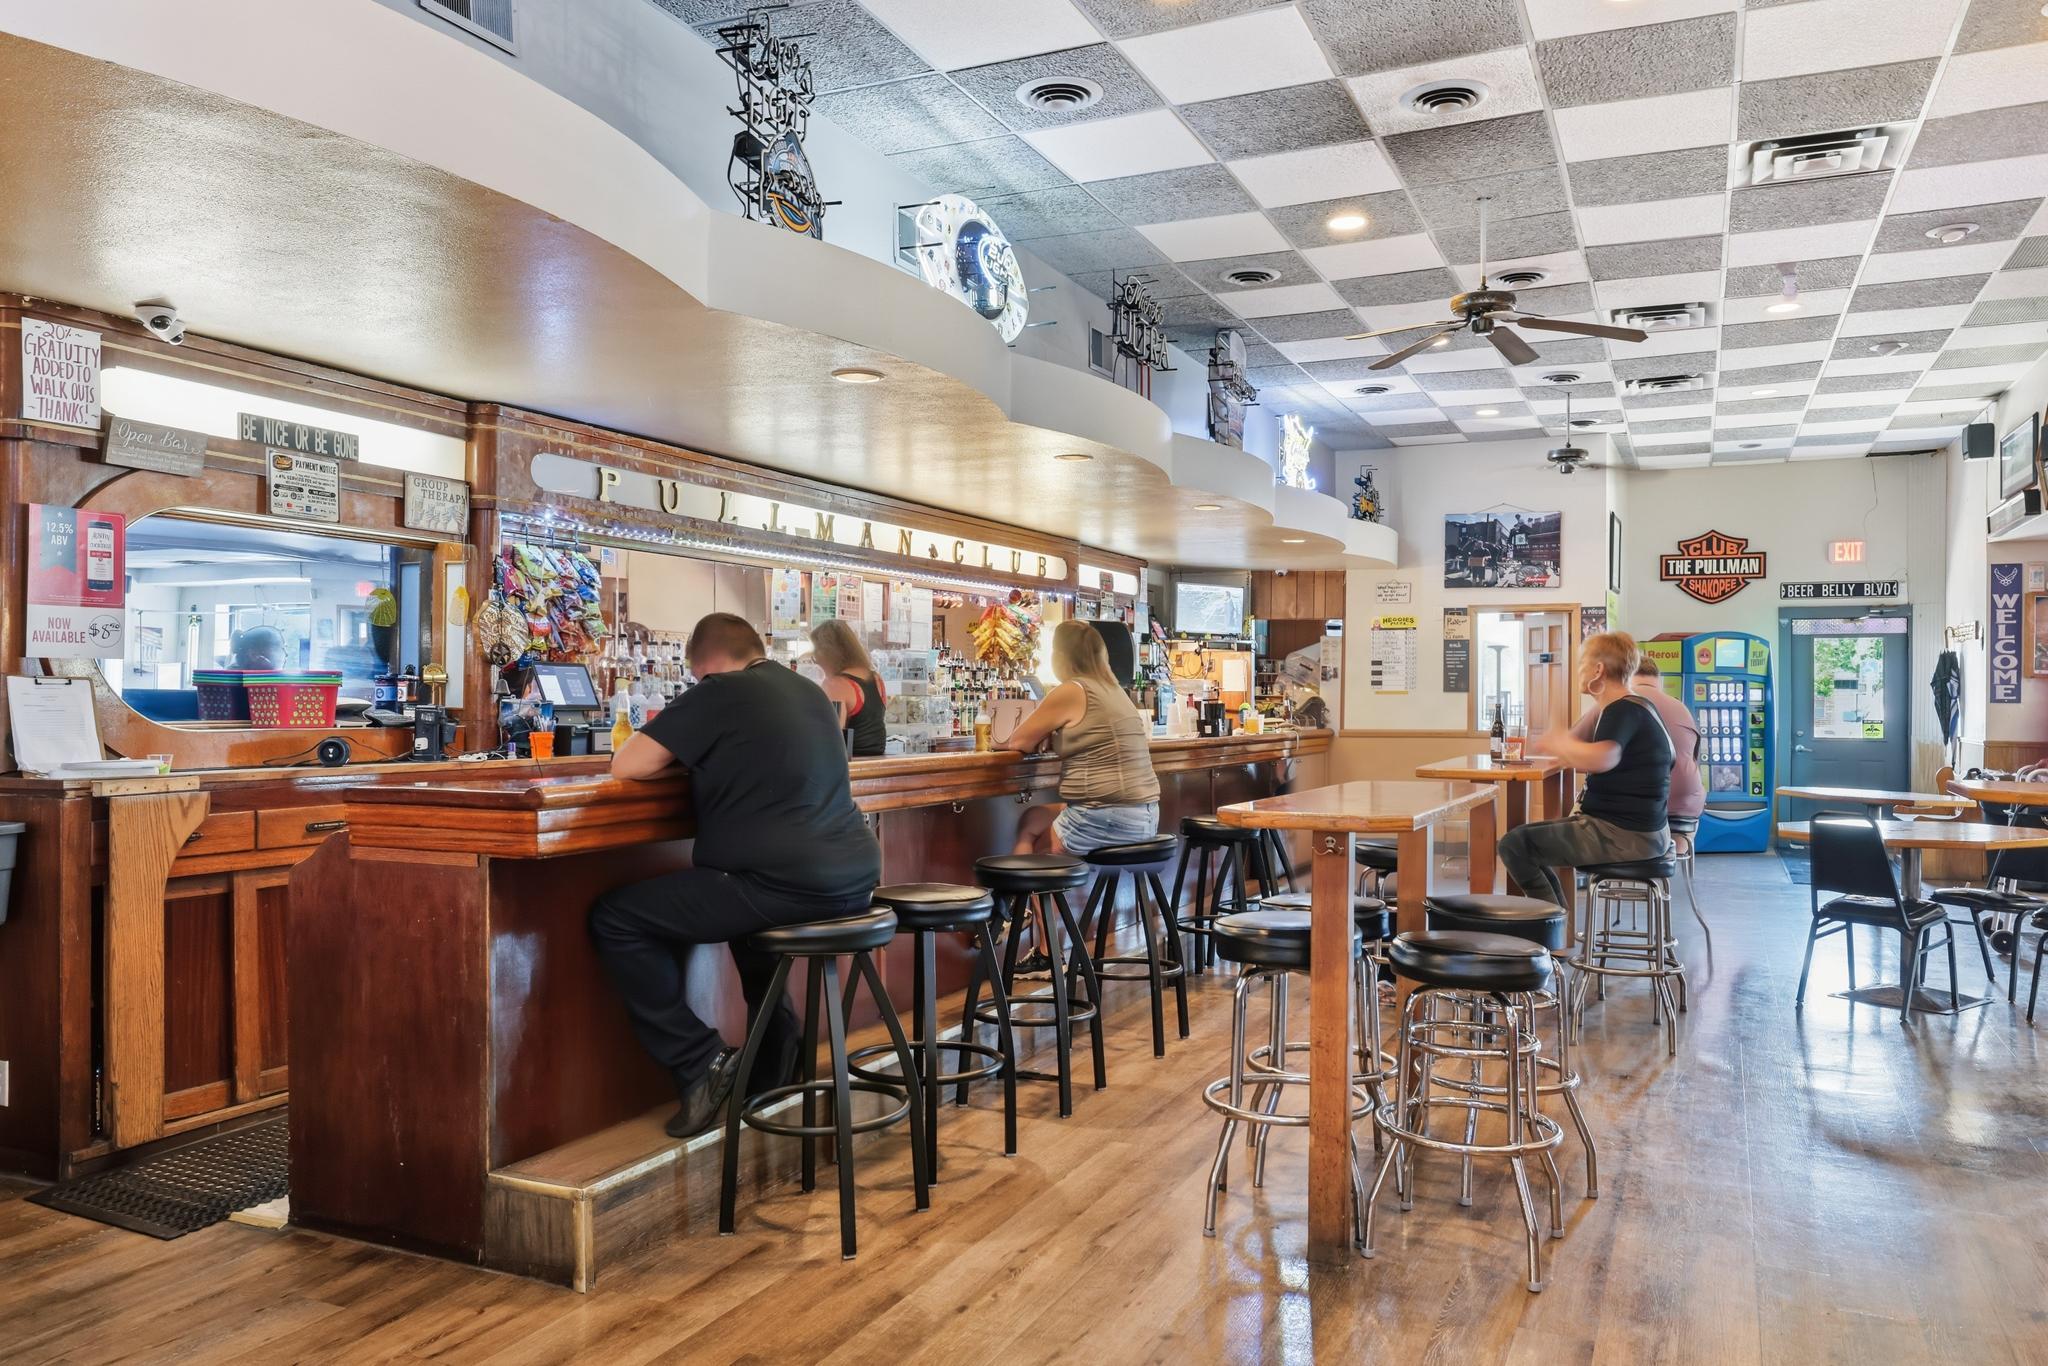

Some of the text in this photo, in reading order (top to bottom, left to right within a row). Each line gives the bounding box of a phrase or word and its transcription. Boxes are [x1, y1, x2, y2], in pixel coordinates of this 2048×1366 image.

[42, 322, 72, 341] 20%
[24, 333, 100, 368] GRATUITY
[33, 357, 92, 383] ADDED TO
[30, 374, 95, 404] WALK OUTS
[35, 396, 89, 425] THANKS!
[118, 421, 201, 455] Open Bar
[242, 414, 359, 460] BE NICE OR BE GONE
[295, 459, 319, 472] PAYMENT
[319, 464, 337, 476] NOTICE
[413, 477, 449, 492] GROUP
[421, 488, 467, 505] THERAPY
[46, 521, 74, 535] 12.5%
[597, 466, 1048, 578] PULLMAN CLUB
[50, 534, 69, 546] ABV
[1688, 536, 1738, 556] CLUB
[1834, 541, 1864, 561] EXIT
[1667, 558, 1760, 575] THE PULLMAN
[1688, 578, 1737, 598] SHAKOPEE
[1787, 582, 1891, 597] BEER BELLY BLVD
[47, 616, 72, 630] NOW
[32, 630, 86, 644] AVAILABLE
[1992, 593, 2020, 700] WELCOME
